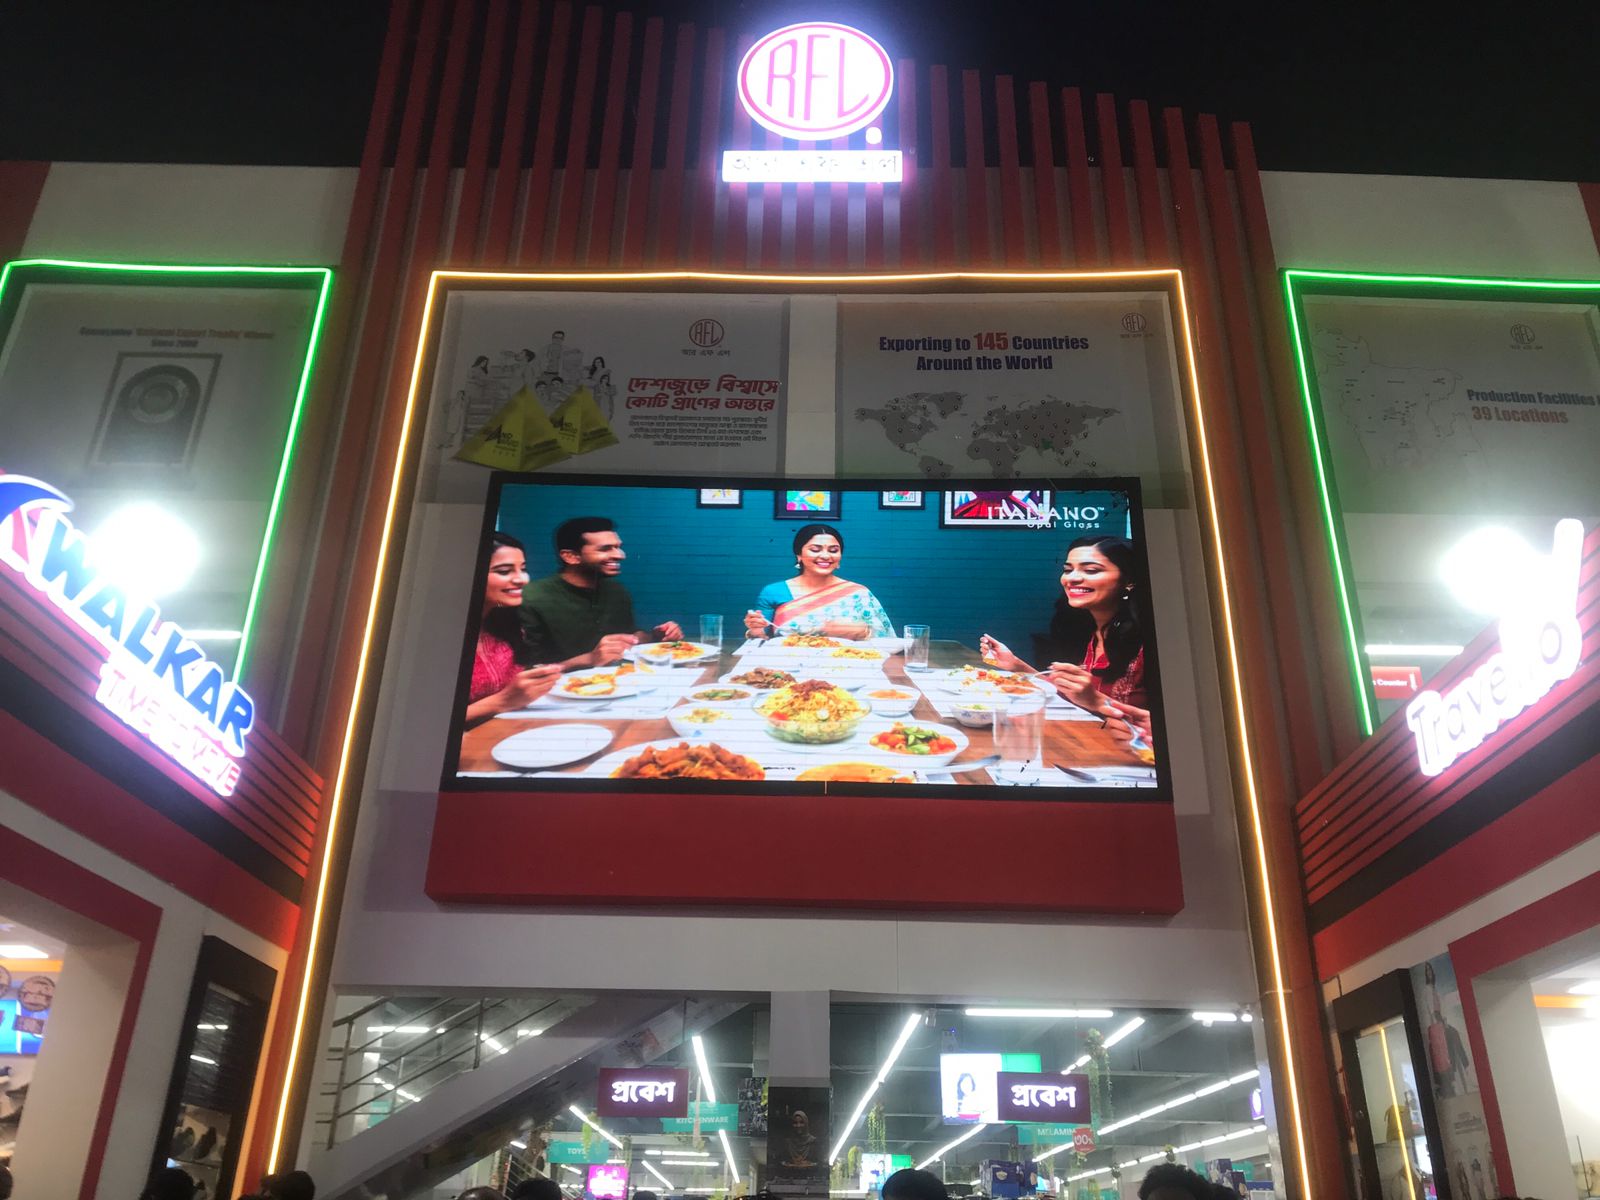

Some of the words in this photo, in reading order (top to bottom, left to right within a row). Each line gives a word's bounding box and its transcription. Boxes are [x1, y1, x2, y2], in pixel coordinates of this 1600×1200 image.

[766, 34, 870, 121] RFL
[693, 320, 720, 346] RFL
[879, 336, 952, 353] Exporting
[955, 337, 971, 351] to
[973, 332, 1009, 351] 145
[1012, 335, 1089, 351] Countries
[916, 356, 973, 371] Around
[975, 356, 1002, 371] the
[1004, 355, 1053, 370] World
[627, 376, 711, 396] দেশজুড়ে
[715, 373, 780, 395] বিশ্বাসে
[624, 392, 670, 410] কোটি
[671, 396, 720, 412] প্রাণের
[723, 397, 776, 412] অন্তরে
[1467, 389, 1537, 404] Production
[1537, 391, 1595, 406] Facilities
[1471, 405, 1493, 421] 39
[1495, 406, 1569, 424] Locations
[1064, 520, 1101, 530] Glass
[41, 520, 253, 752] WALKAR
[1411, 620, 1563, 765] Traveo
[610, 1080, 676, 1104] প্রবেশ
[1010, 1084, 1077, 1108] প্রবেশ
[675, 1115, 729, 1125] KITCENWARE
